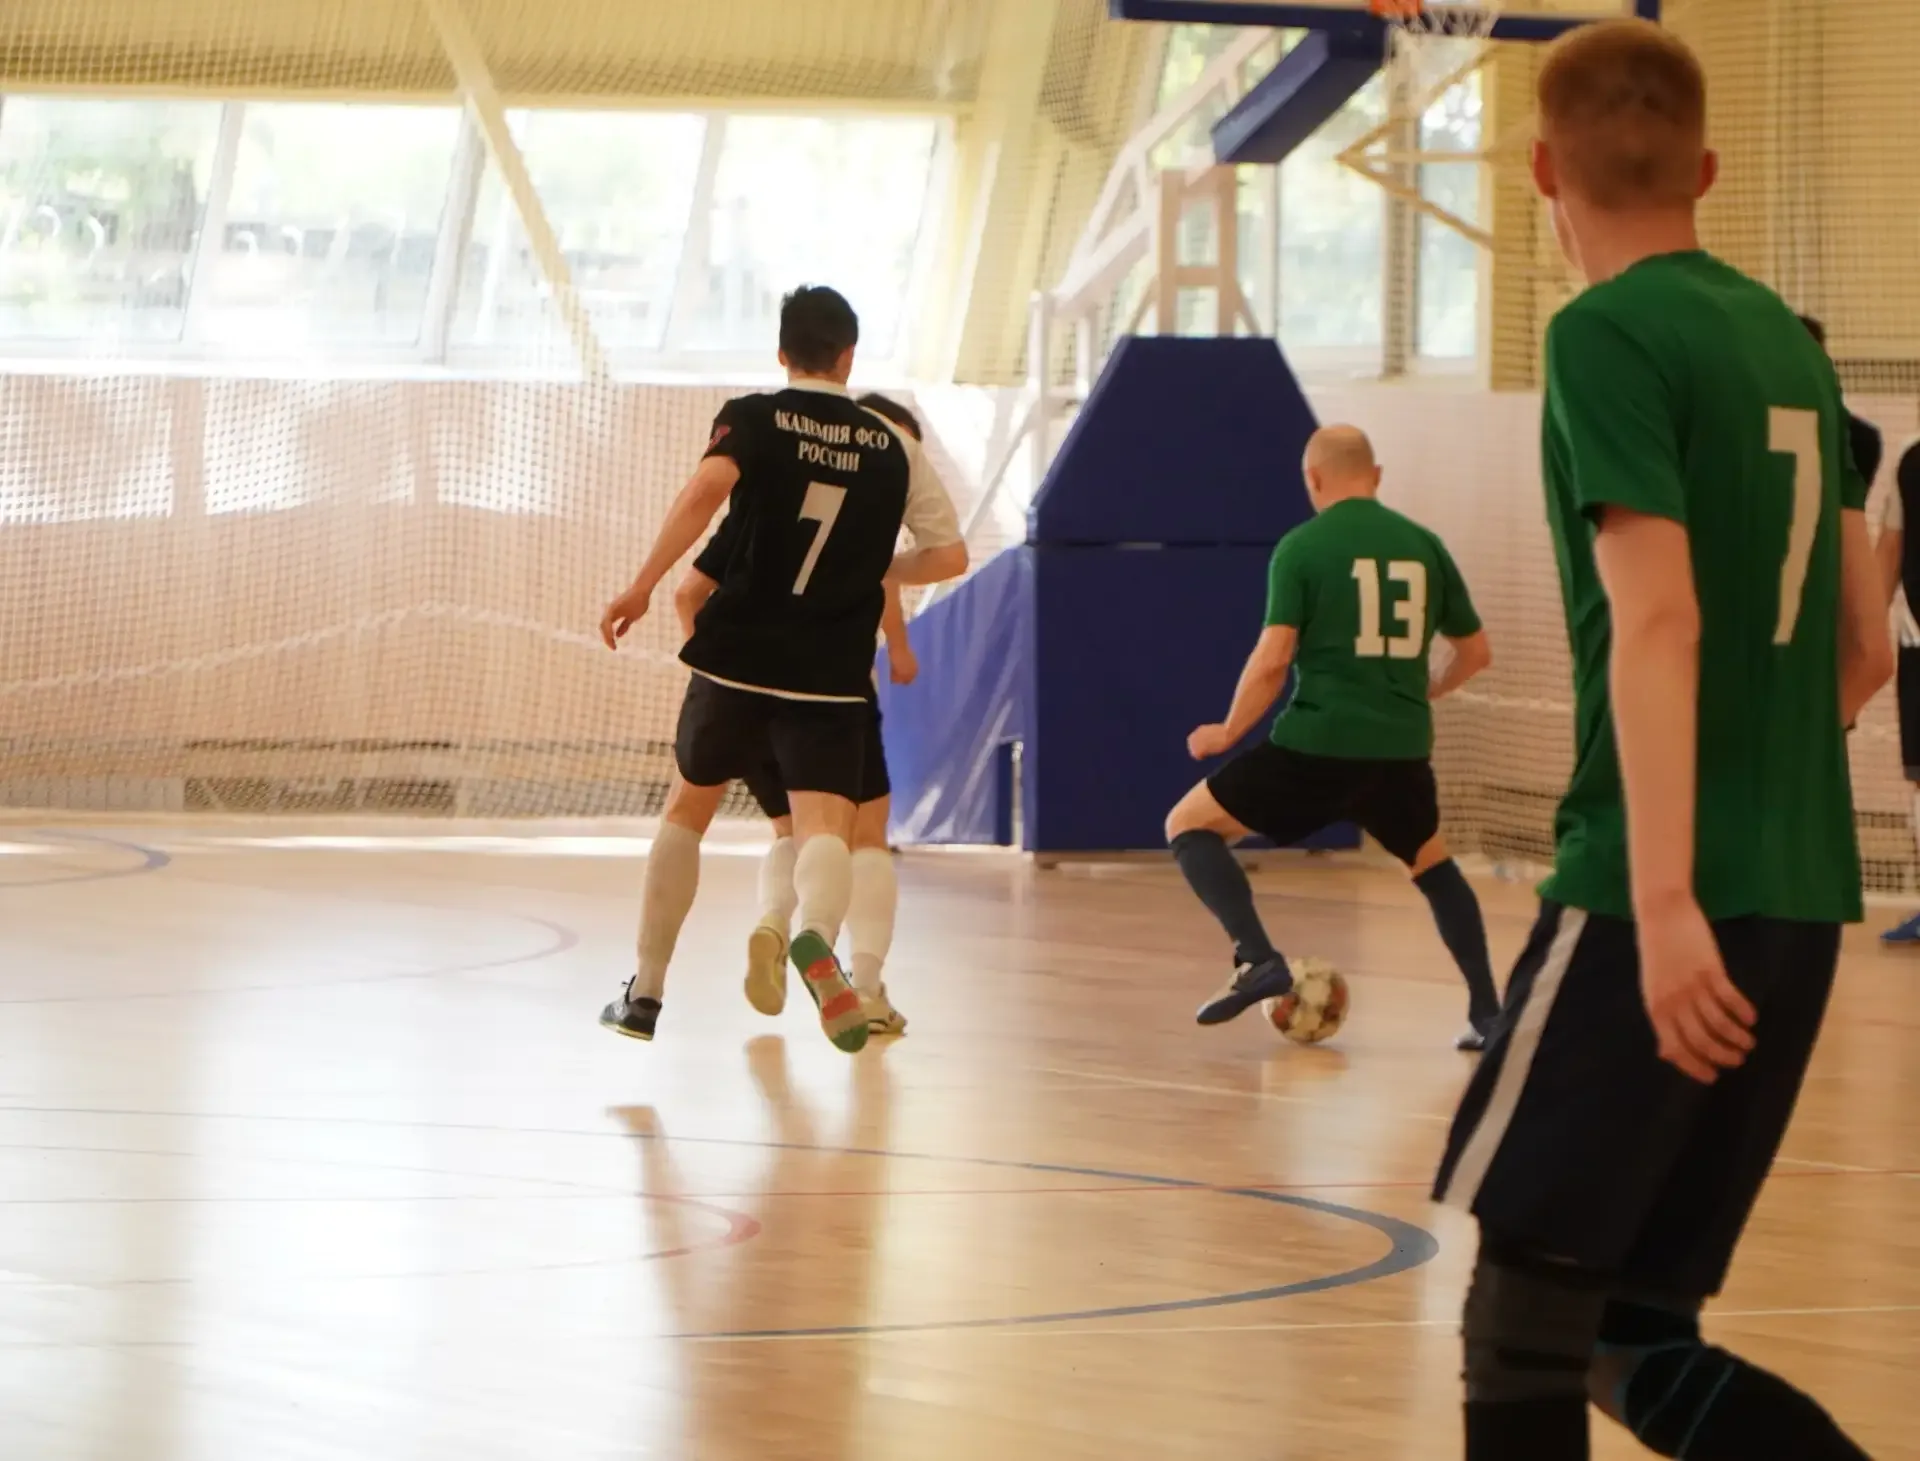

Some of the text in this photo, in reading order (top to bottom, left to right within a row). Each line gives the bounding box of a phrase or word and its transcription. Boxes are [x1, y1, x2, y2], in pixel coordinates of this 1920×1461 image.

[797, 440, 860, 472] РОССИИ
[854, 426, 890, 450] ФСО
[791, 480, 848, 596] 7
[1767, 405, 1822, 645] 7
[1350, 558, 1427, 659] 13
